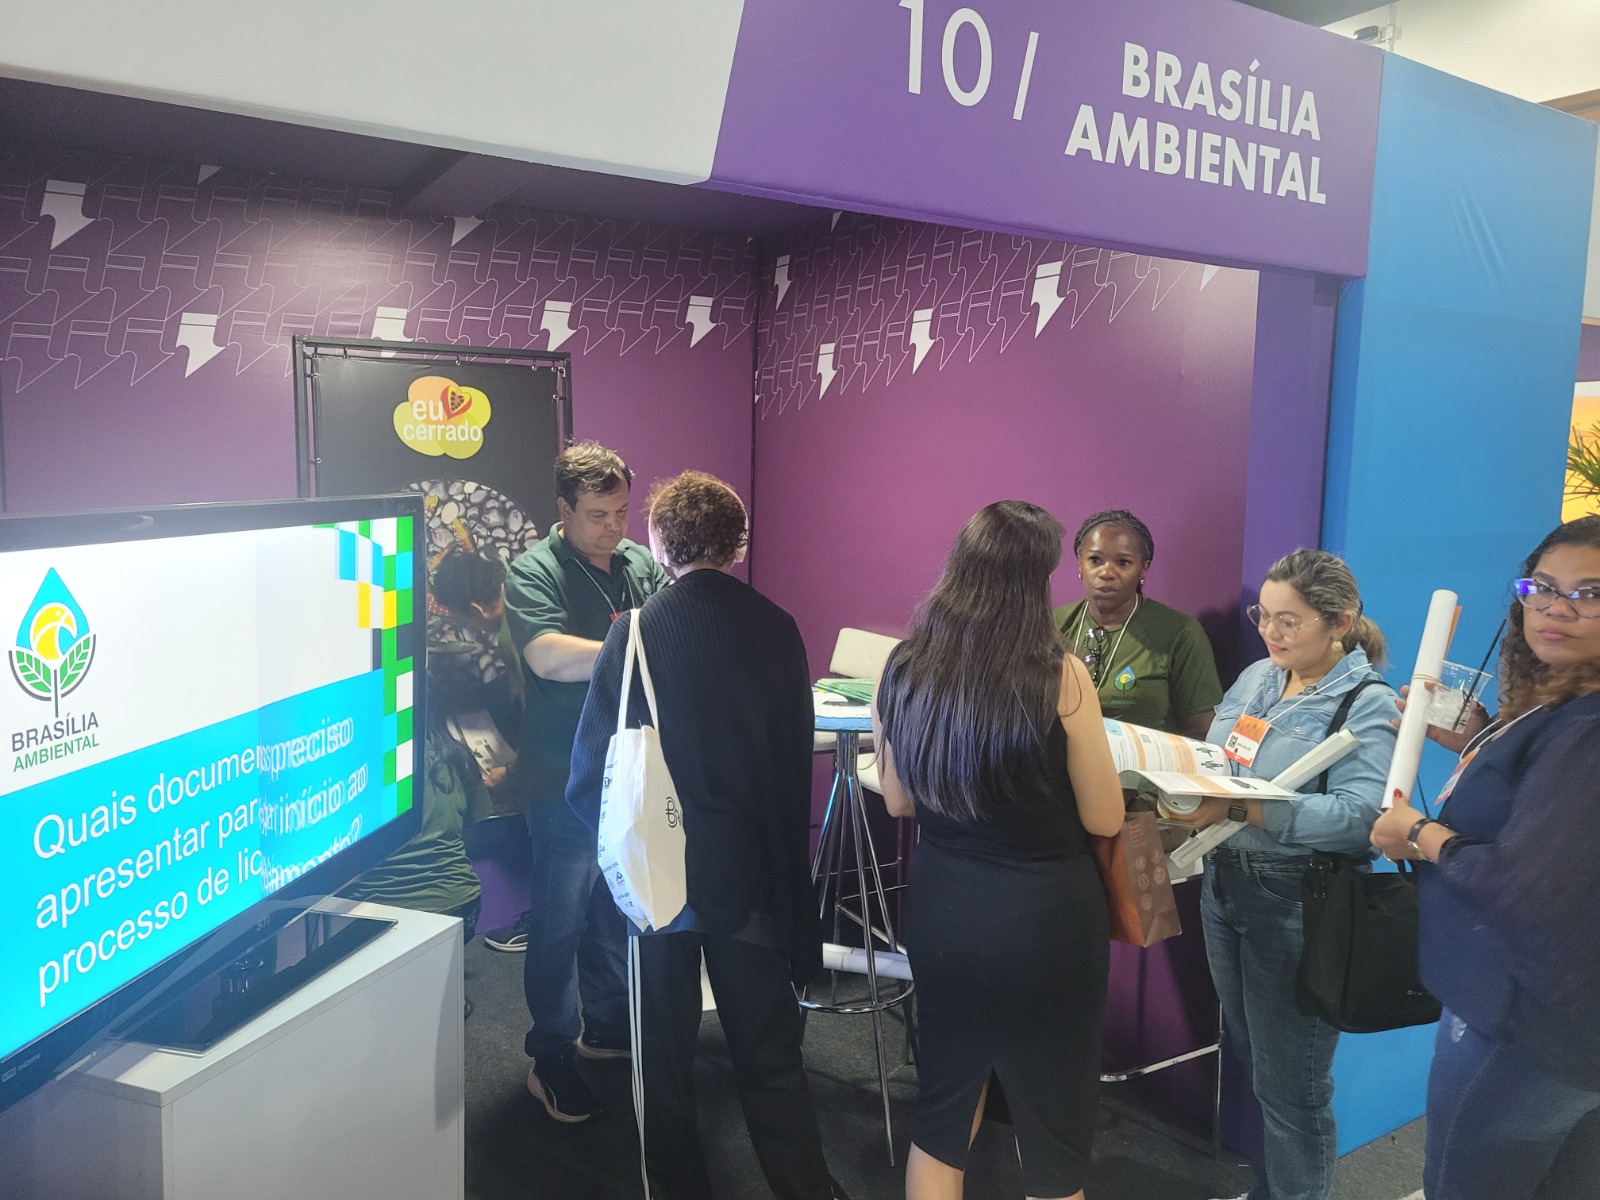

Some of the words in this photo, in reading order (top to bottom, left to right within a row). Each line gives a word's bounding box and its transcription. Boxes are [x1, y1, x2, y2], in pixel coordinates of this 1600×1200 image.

[898, 0, 993, 107] 10
[1121, 41, 1321, 141] BRASÍLIA
[1064, 104, 1327, 205] AMBIENTAL
[403, 419, 481, 442] cerrado
[412, 399, 444, 422] eu
[11, 711, 99, 753] BRASÍLIA
[13, 733, 100, 773] AMBIENTAL
[33, 790, 137, 859] Quais
[35, 820, 210, 930] apresentar
[38, 890, 189, 1009] processo
[197, 866, 229, 906] de
